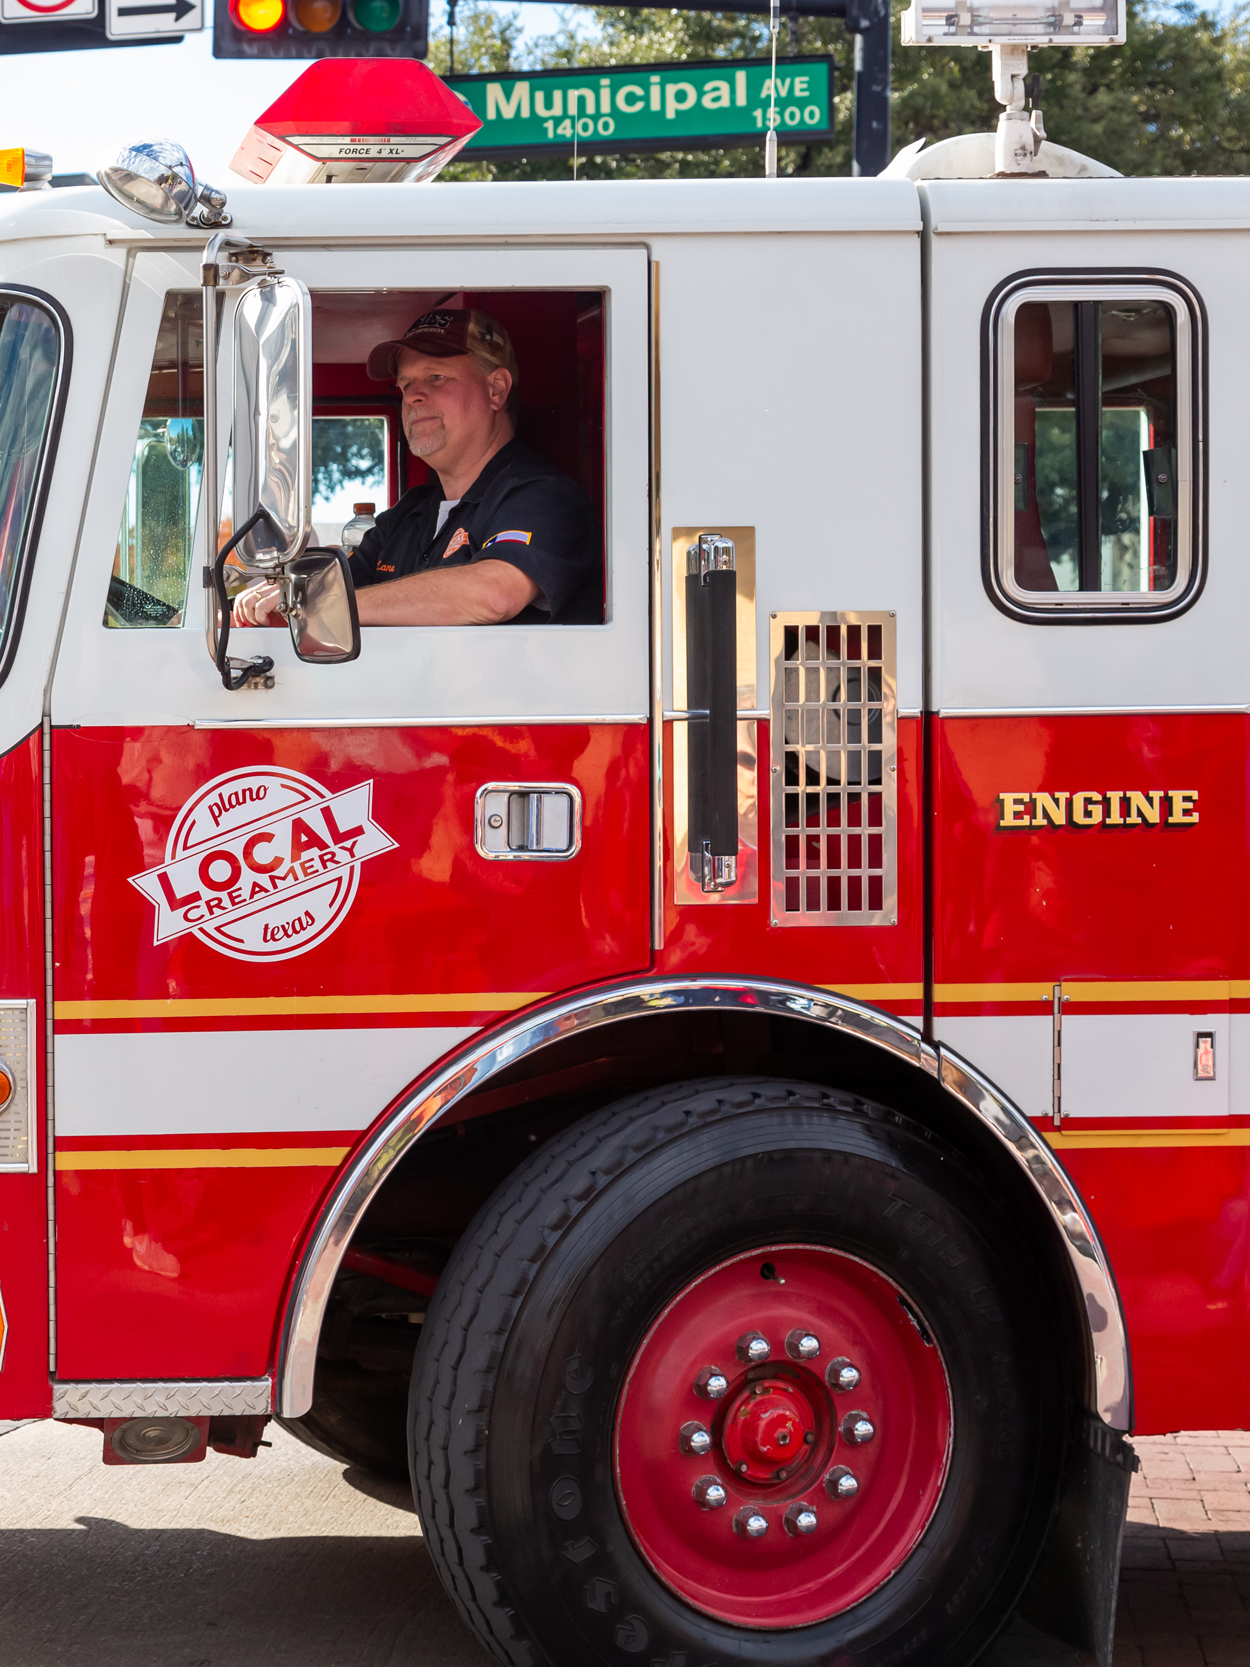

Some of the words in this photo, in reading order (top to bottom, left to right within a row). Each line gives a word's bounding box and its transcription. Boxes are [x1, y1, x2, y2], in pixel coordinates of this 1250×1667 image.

[486, 71, 747, 120] Municipal
[760, 76, 810, 98] AVE
[543, 117, 615, 139] 1400
[753, 106, 821, 128] 1500
[208, 784, 269, 827] plano
[998, 790, 1200, 830] ENGINE
[156, 805, 365, 912] LOCAL
[183, 840, 358, 923] CREAMERY
[262, 909, 315, 943] texas
